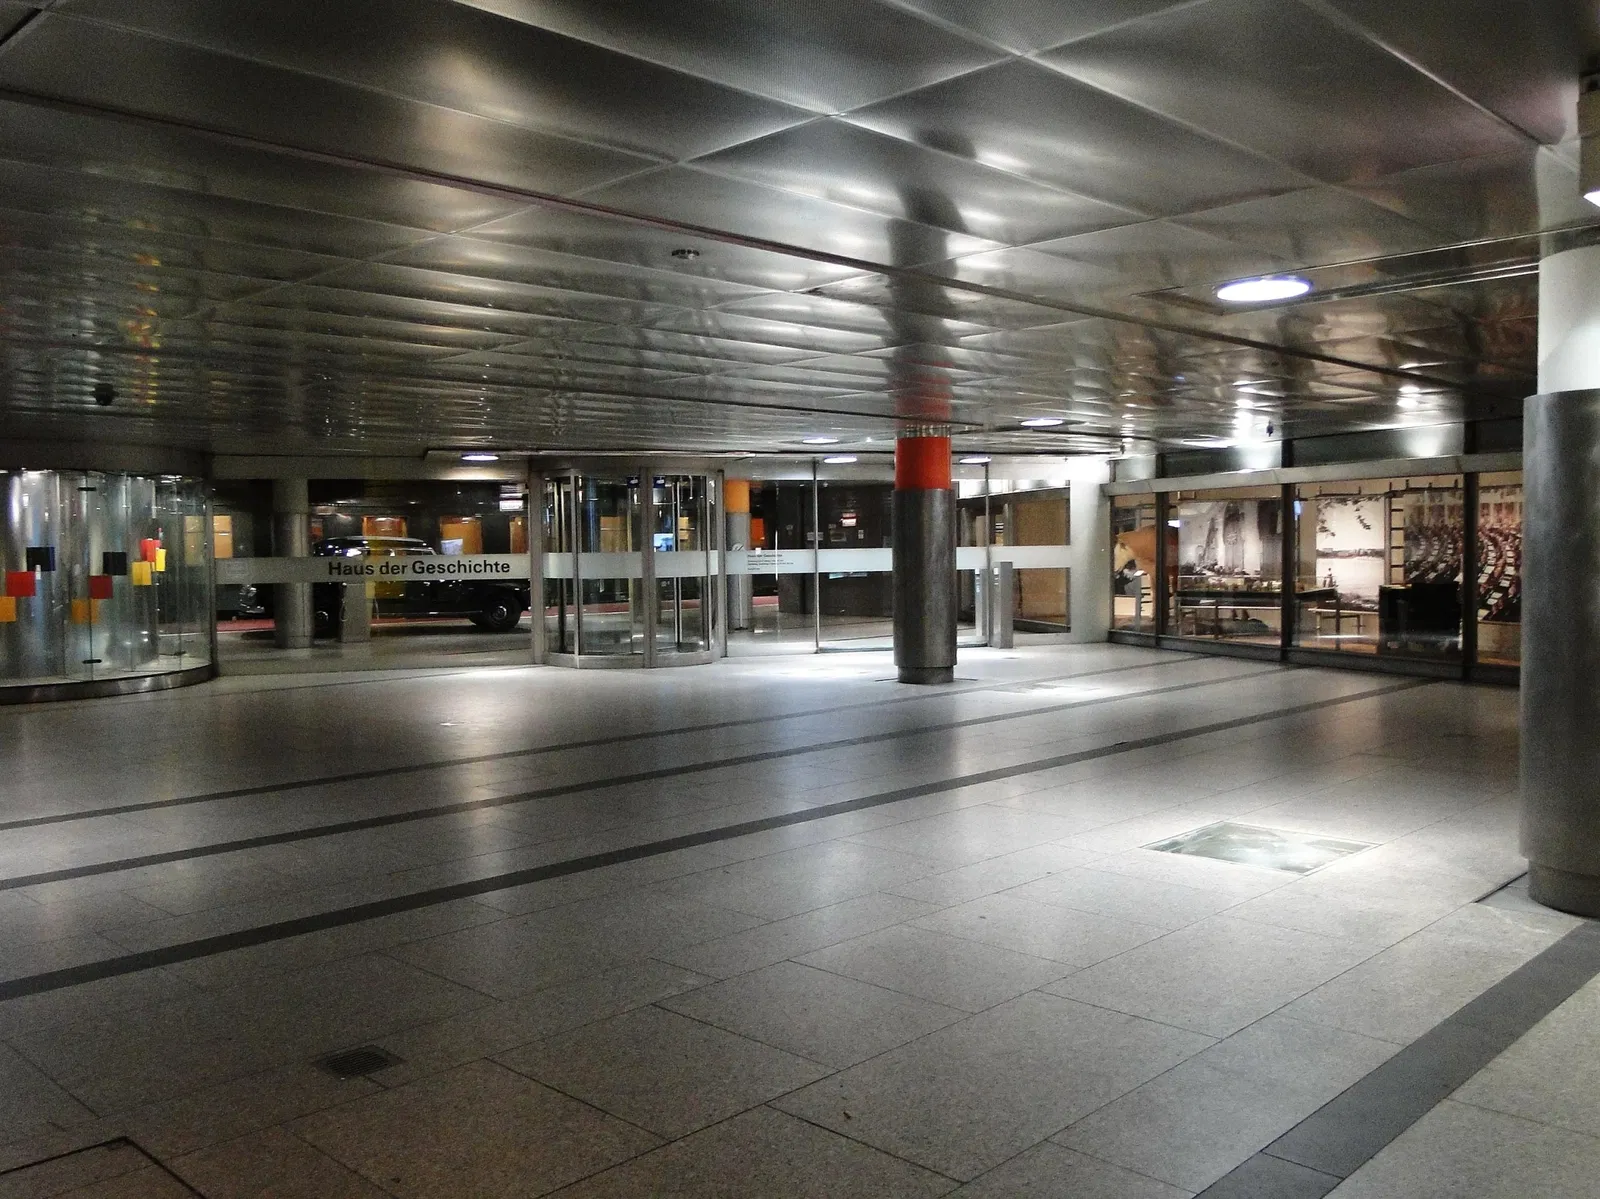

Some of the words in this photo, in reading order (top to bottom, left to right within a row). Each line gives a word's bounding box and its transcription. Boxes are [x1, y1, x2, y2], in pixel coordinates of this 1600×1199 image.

[328, 561, 374, 576] Haus
[379, 561, 408, 575] der
[412, 559, 511, 575] Geschichte
